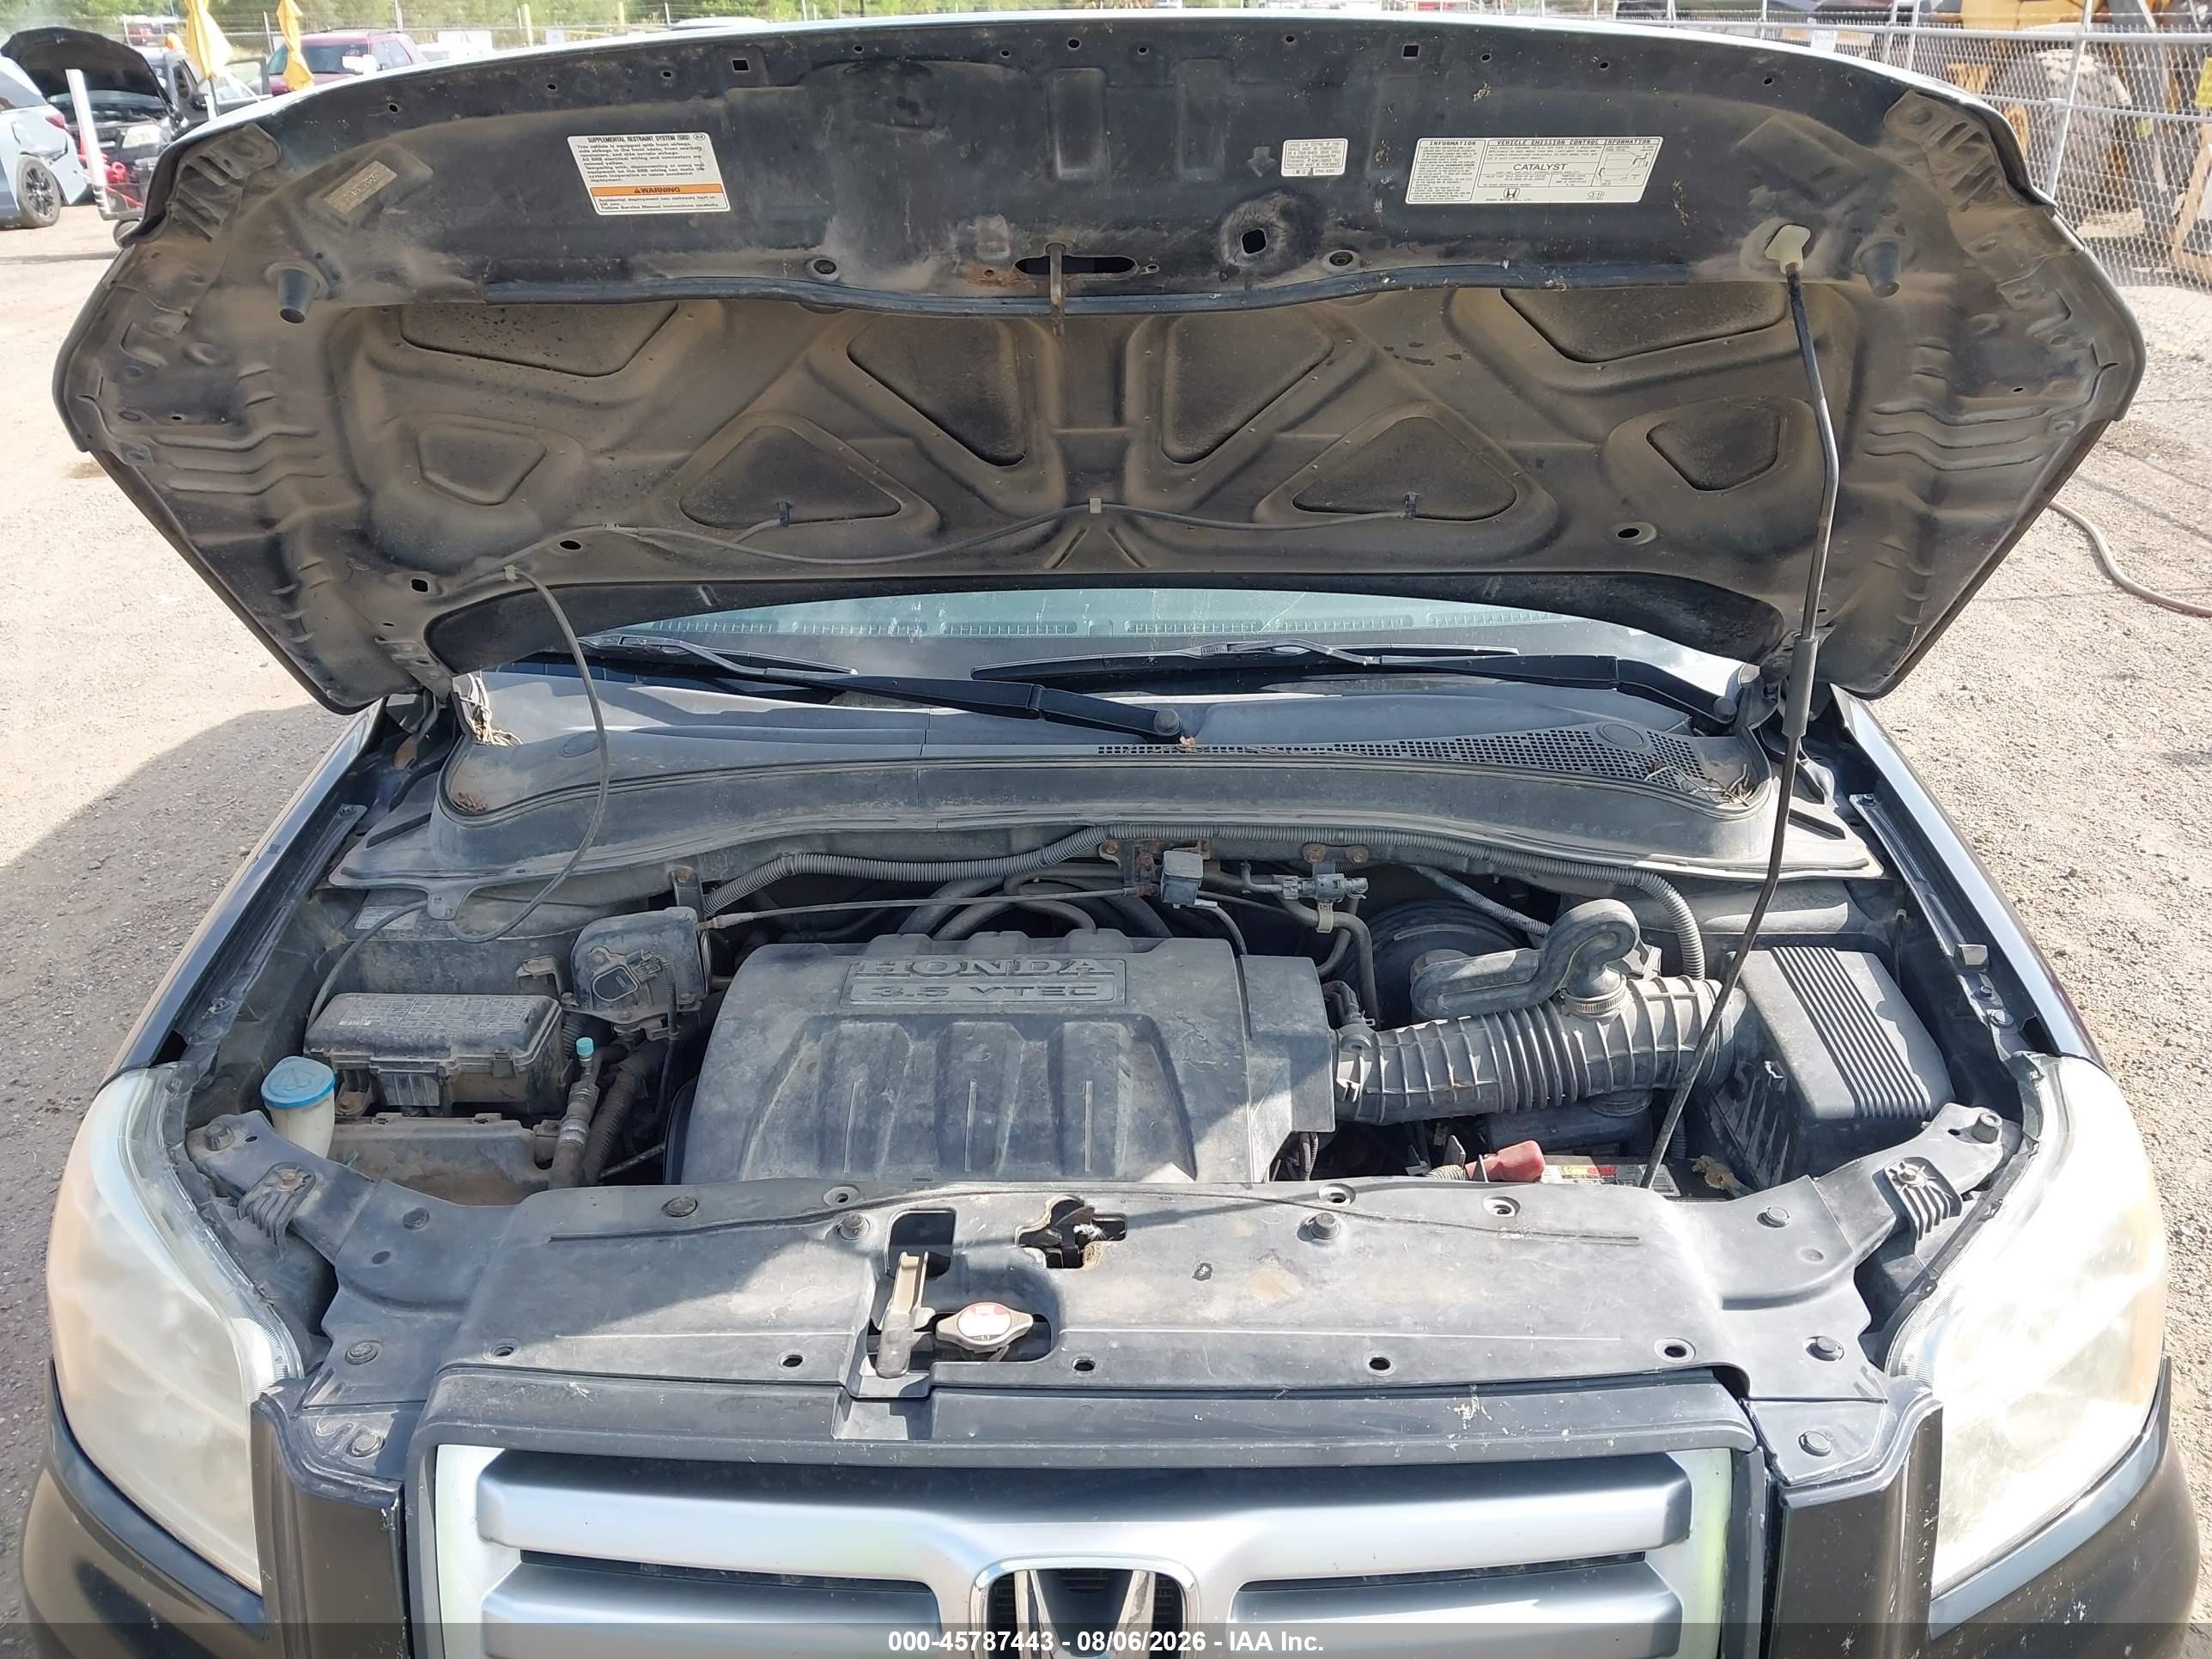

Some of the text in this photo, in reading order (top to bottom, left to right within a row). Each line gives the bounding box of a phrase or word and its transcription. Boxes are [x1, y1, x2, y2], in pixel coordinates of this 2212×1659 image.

[855, 958, 1115, 978] HONDA
[870, 985, 1098, 997] 3.5 VTEC
